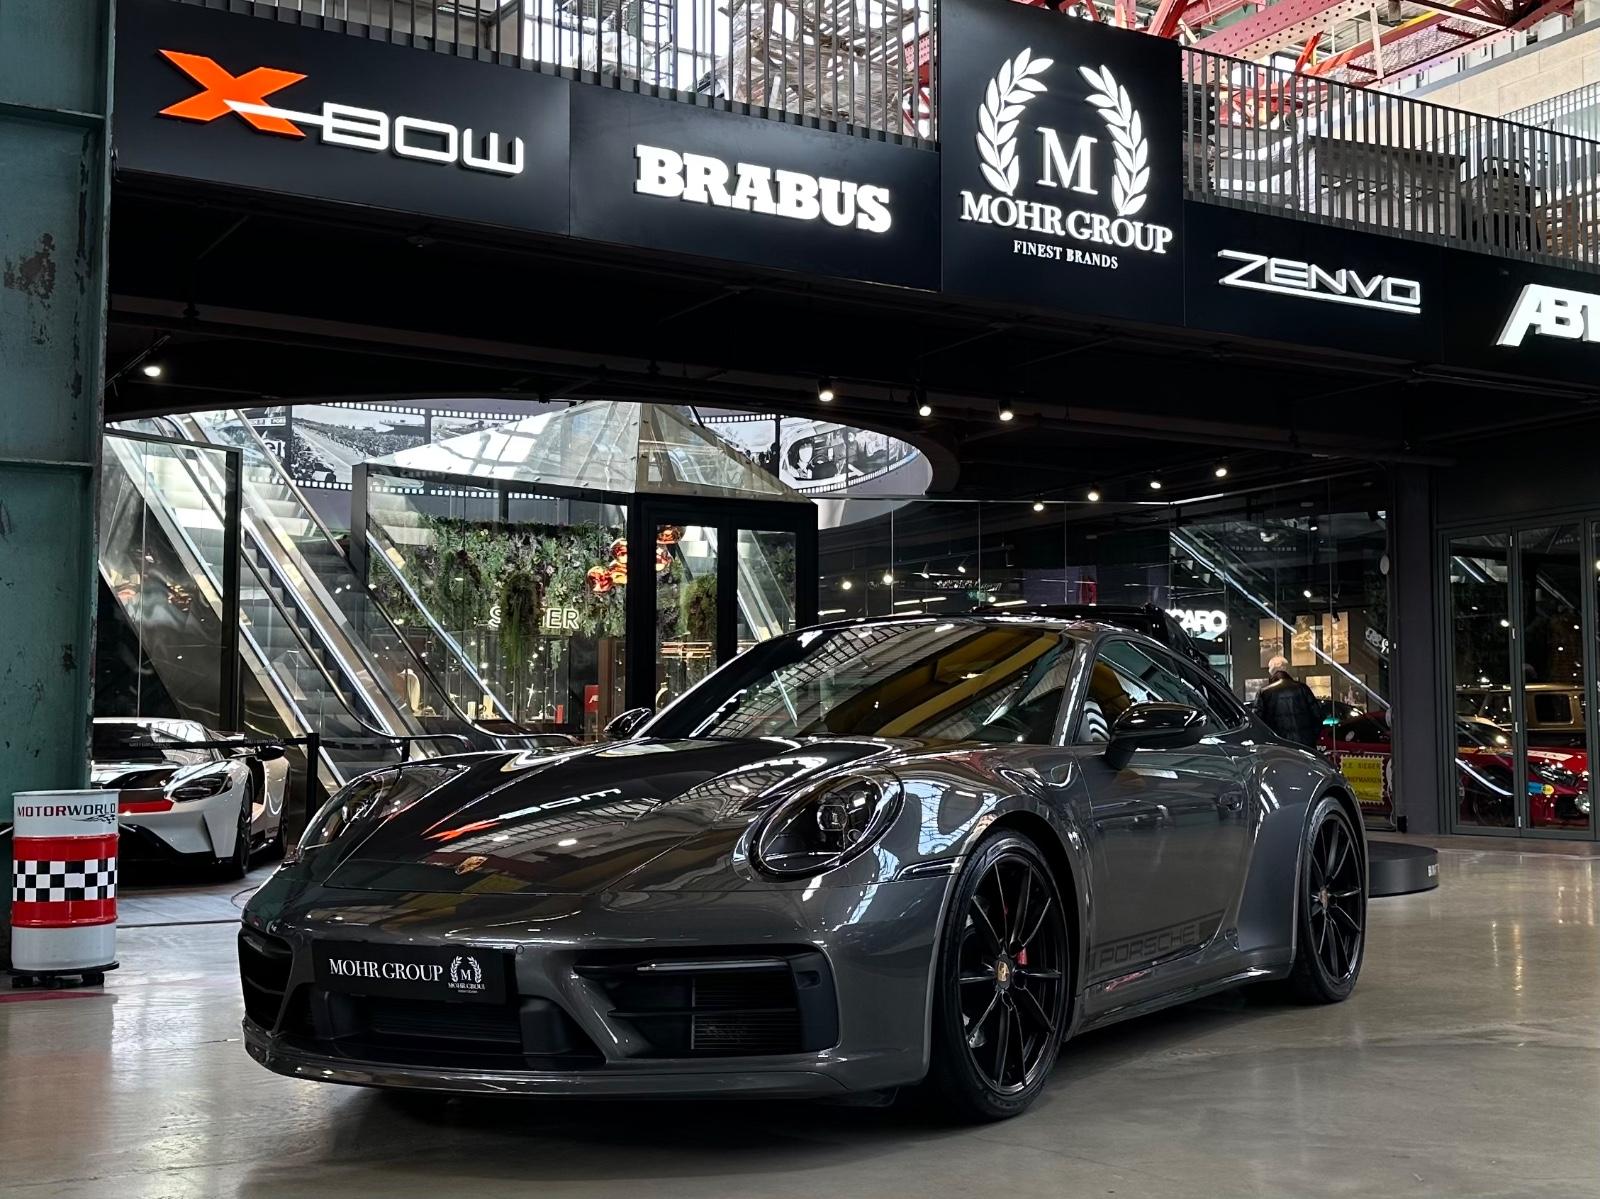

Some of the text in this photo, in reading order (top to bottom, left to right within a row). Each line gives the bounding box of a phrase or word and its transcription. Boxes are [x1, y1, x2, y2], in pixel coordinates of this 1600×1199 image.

[1037, 126, 1099, 196] M
[635, 143, 893, 234] BRABUS
[960, 190, 1173, 254] MOHR GROUP
[1013, 239, 1119, 269] FINEST BRANDS
[1218, 249, 1421, 312] ZENVO
[17, 803, 116, 818] MOTORWORLD
[1100, 924, 1195, 963] PORSCHE
[329, 958, 444, 982] MOHR GROUP
[460, 969, 471, 981] M
